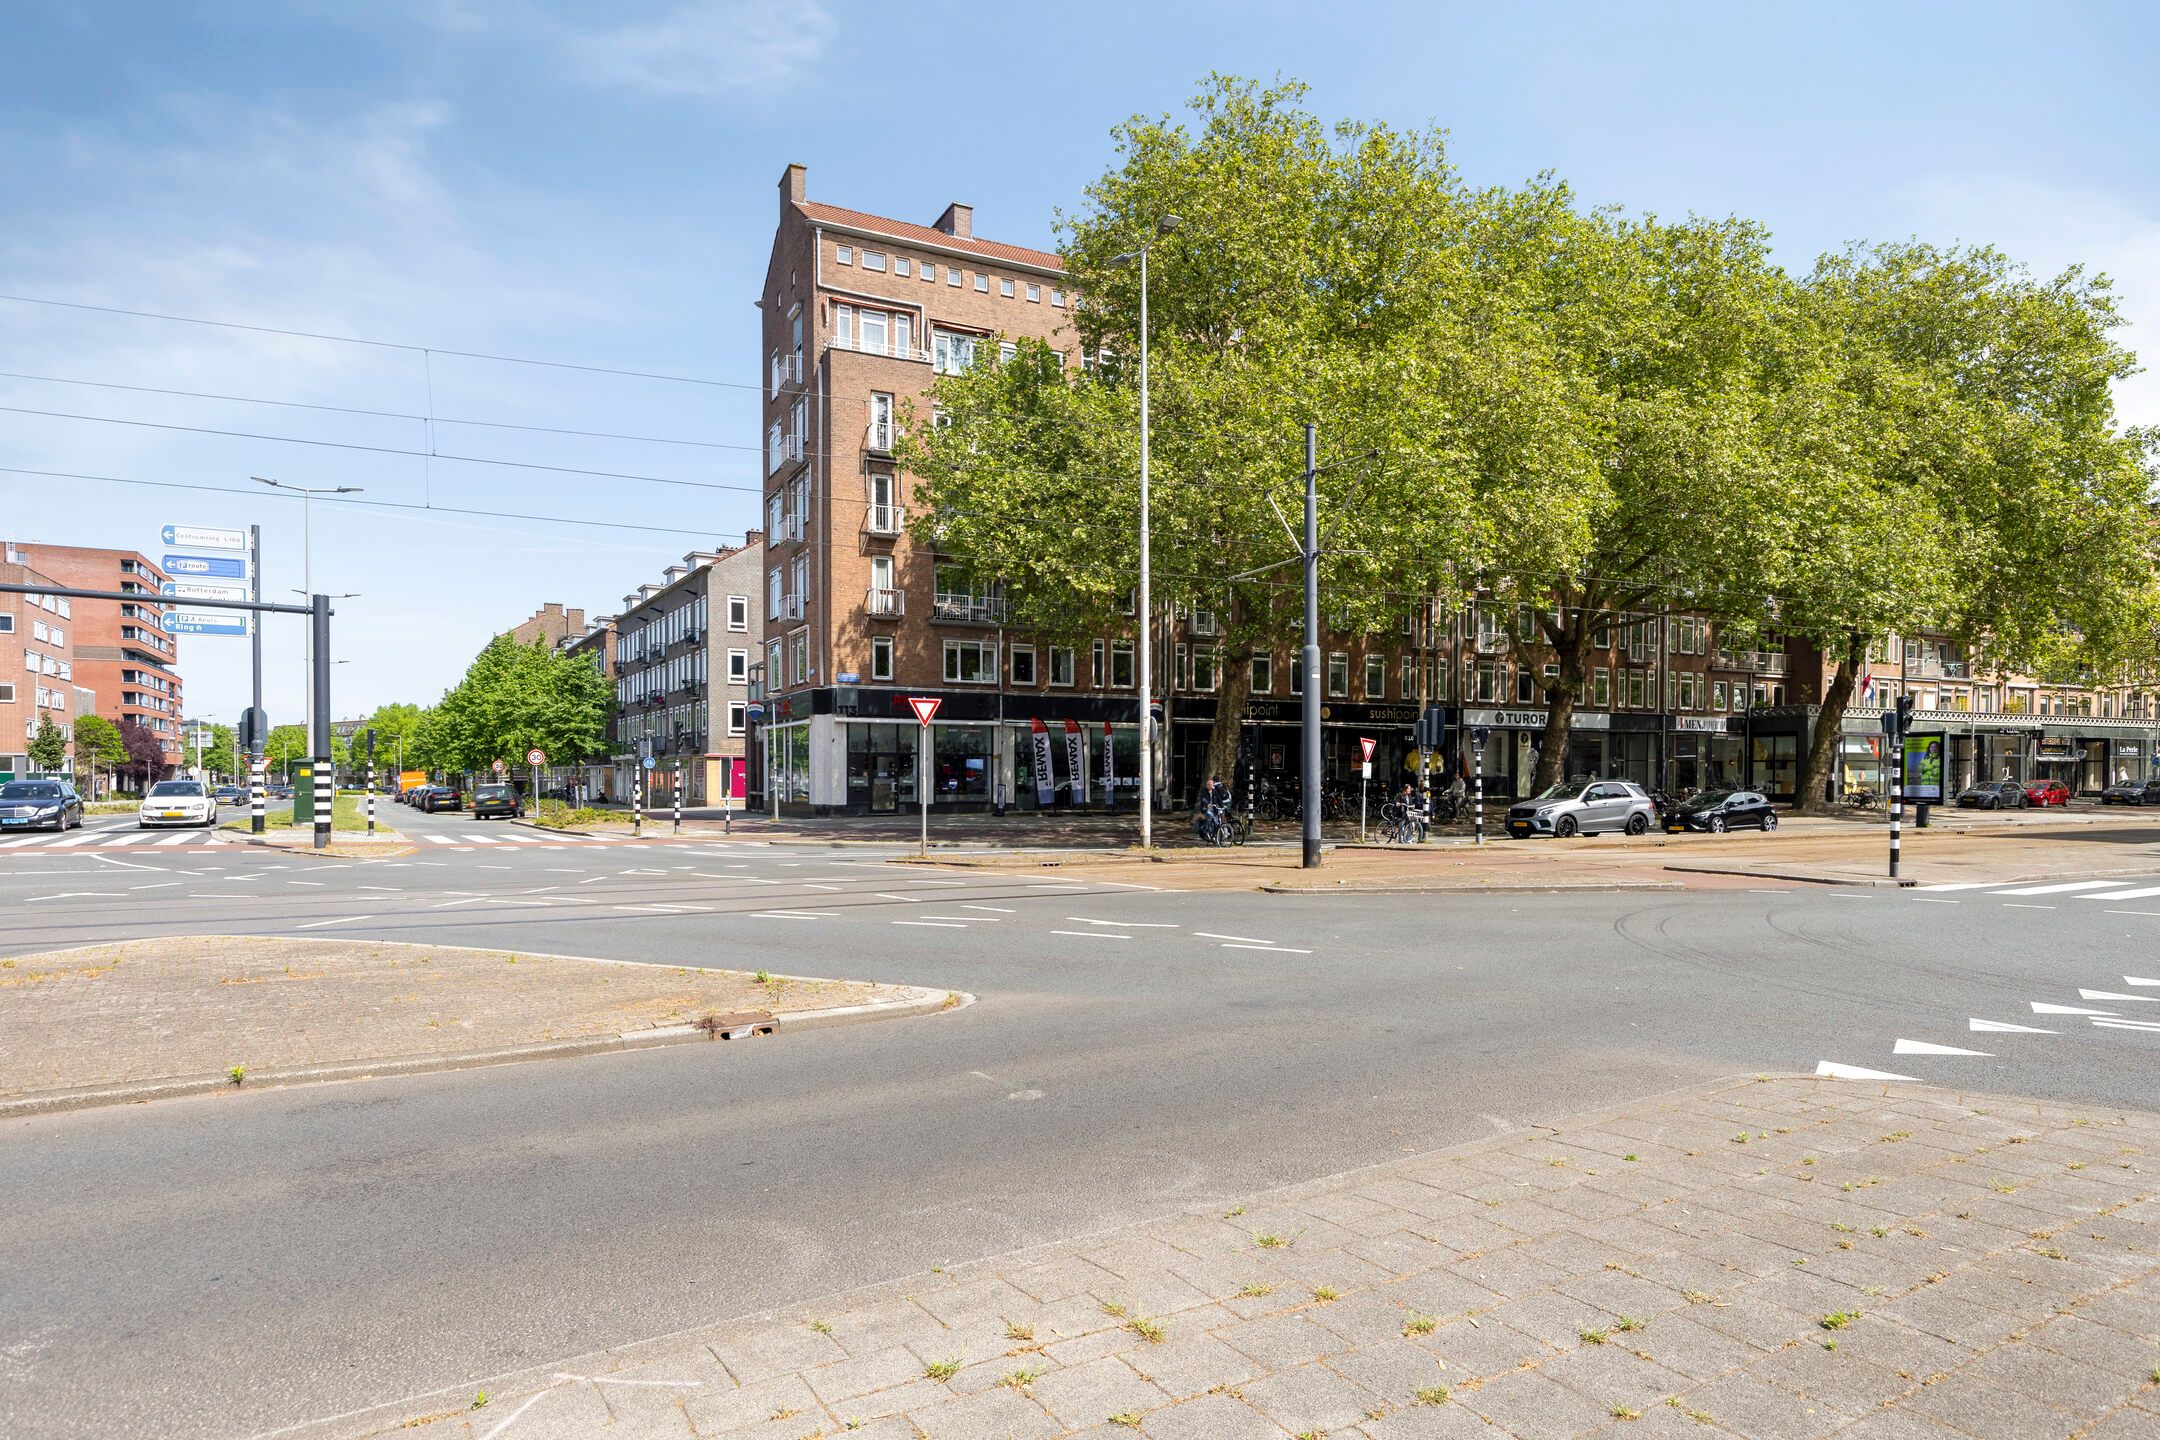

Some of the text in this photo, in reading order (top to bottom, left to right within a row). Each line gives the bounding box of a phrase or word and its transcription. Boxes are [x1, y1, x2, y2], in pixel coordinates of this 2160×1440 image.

[176, 533, 220, 543] Centrumring
[188, 562, 207, 570] route
[186, 586, 229, 595] Rotterdam
[175, 623, 195, 632] Ring
[838, 705, 858, 716] 113
[1242, 702, 1279, 719] ipoint
[1369, 707, 1419, 722] sushipoin
